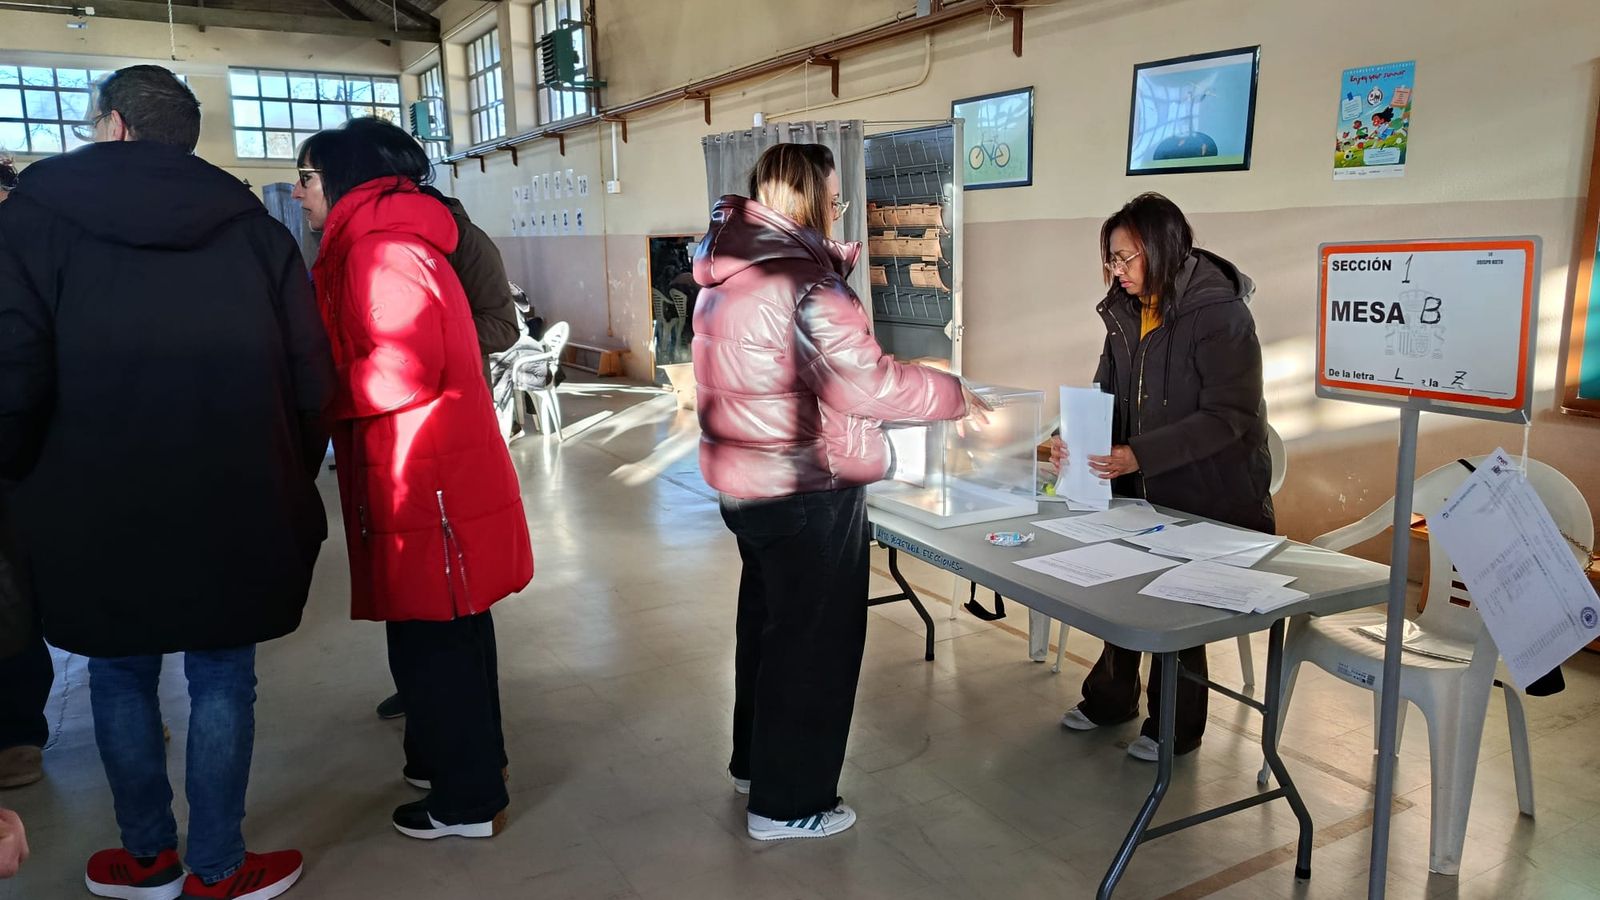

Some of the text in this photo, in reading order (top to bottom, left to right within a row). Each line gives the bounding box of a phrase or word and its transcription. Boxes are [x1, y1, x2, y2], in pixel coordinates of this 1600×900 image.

[1332, 253, 1414, 284] SECCIÓN 1
[1331, 296, 1442, 325] MESA B
[1328, 368, 1340, 377] De
[1342, 369, 1351, 378] la
[1353, 370, 1375, 381] letra
[1394, 367, 1404, 380] L
[1428, 378, 1439, 387] la
[1451, 370, 1468, 386] Z
